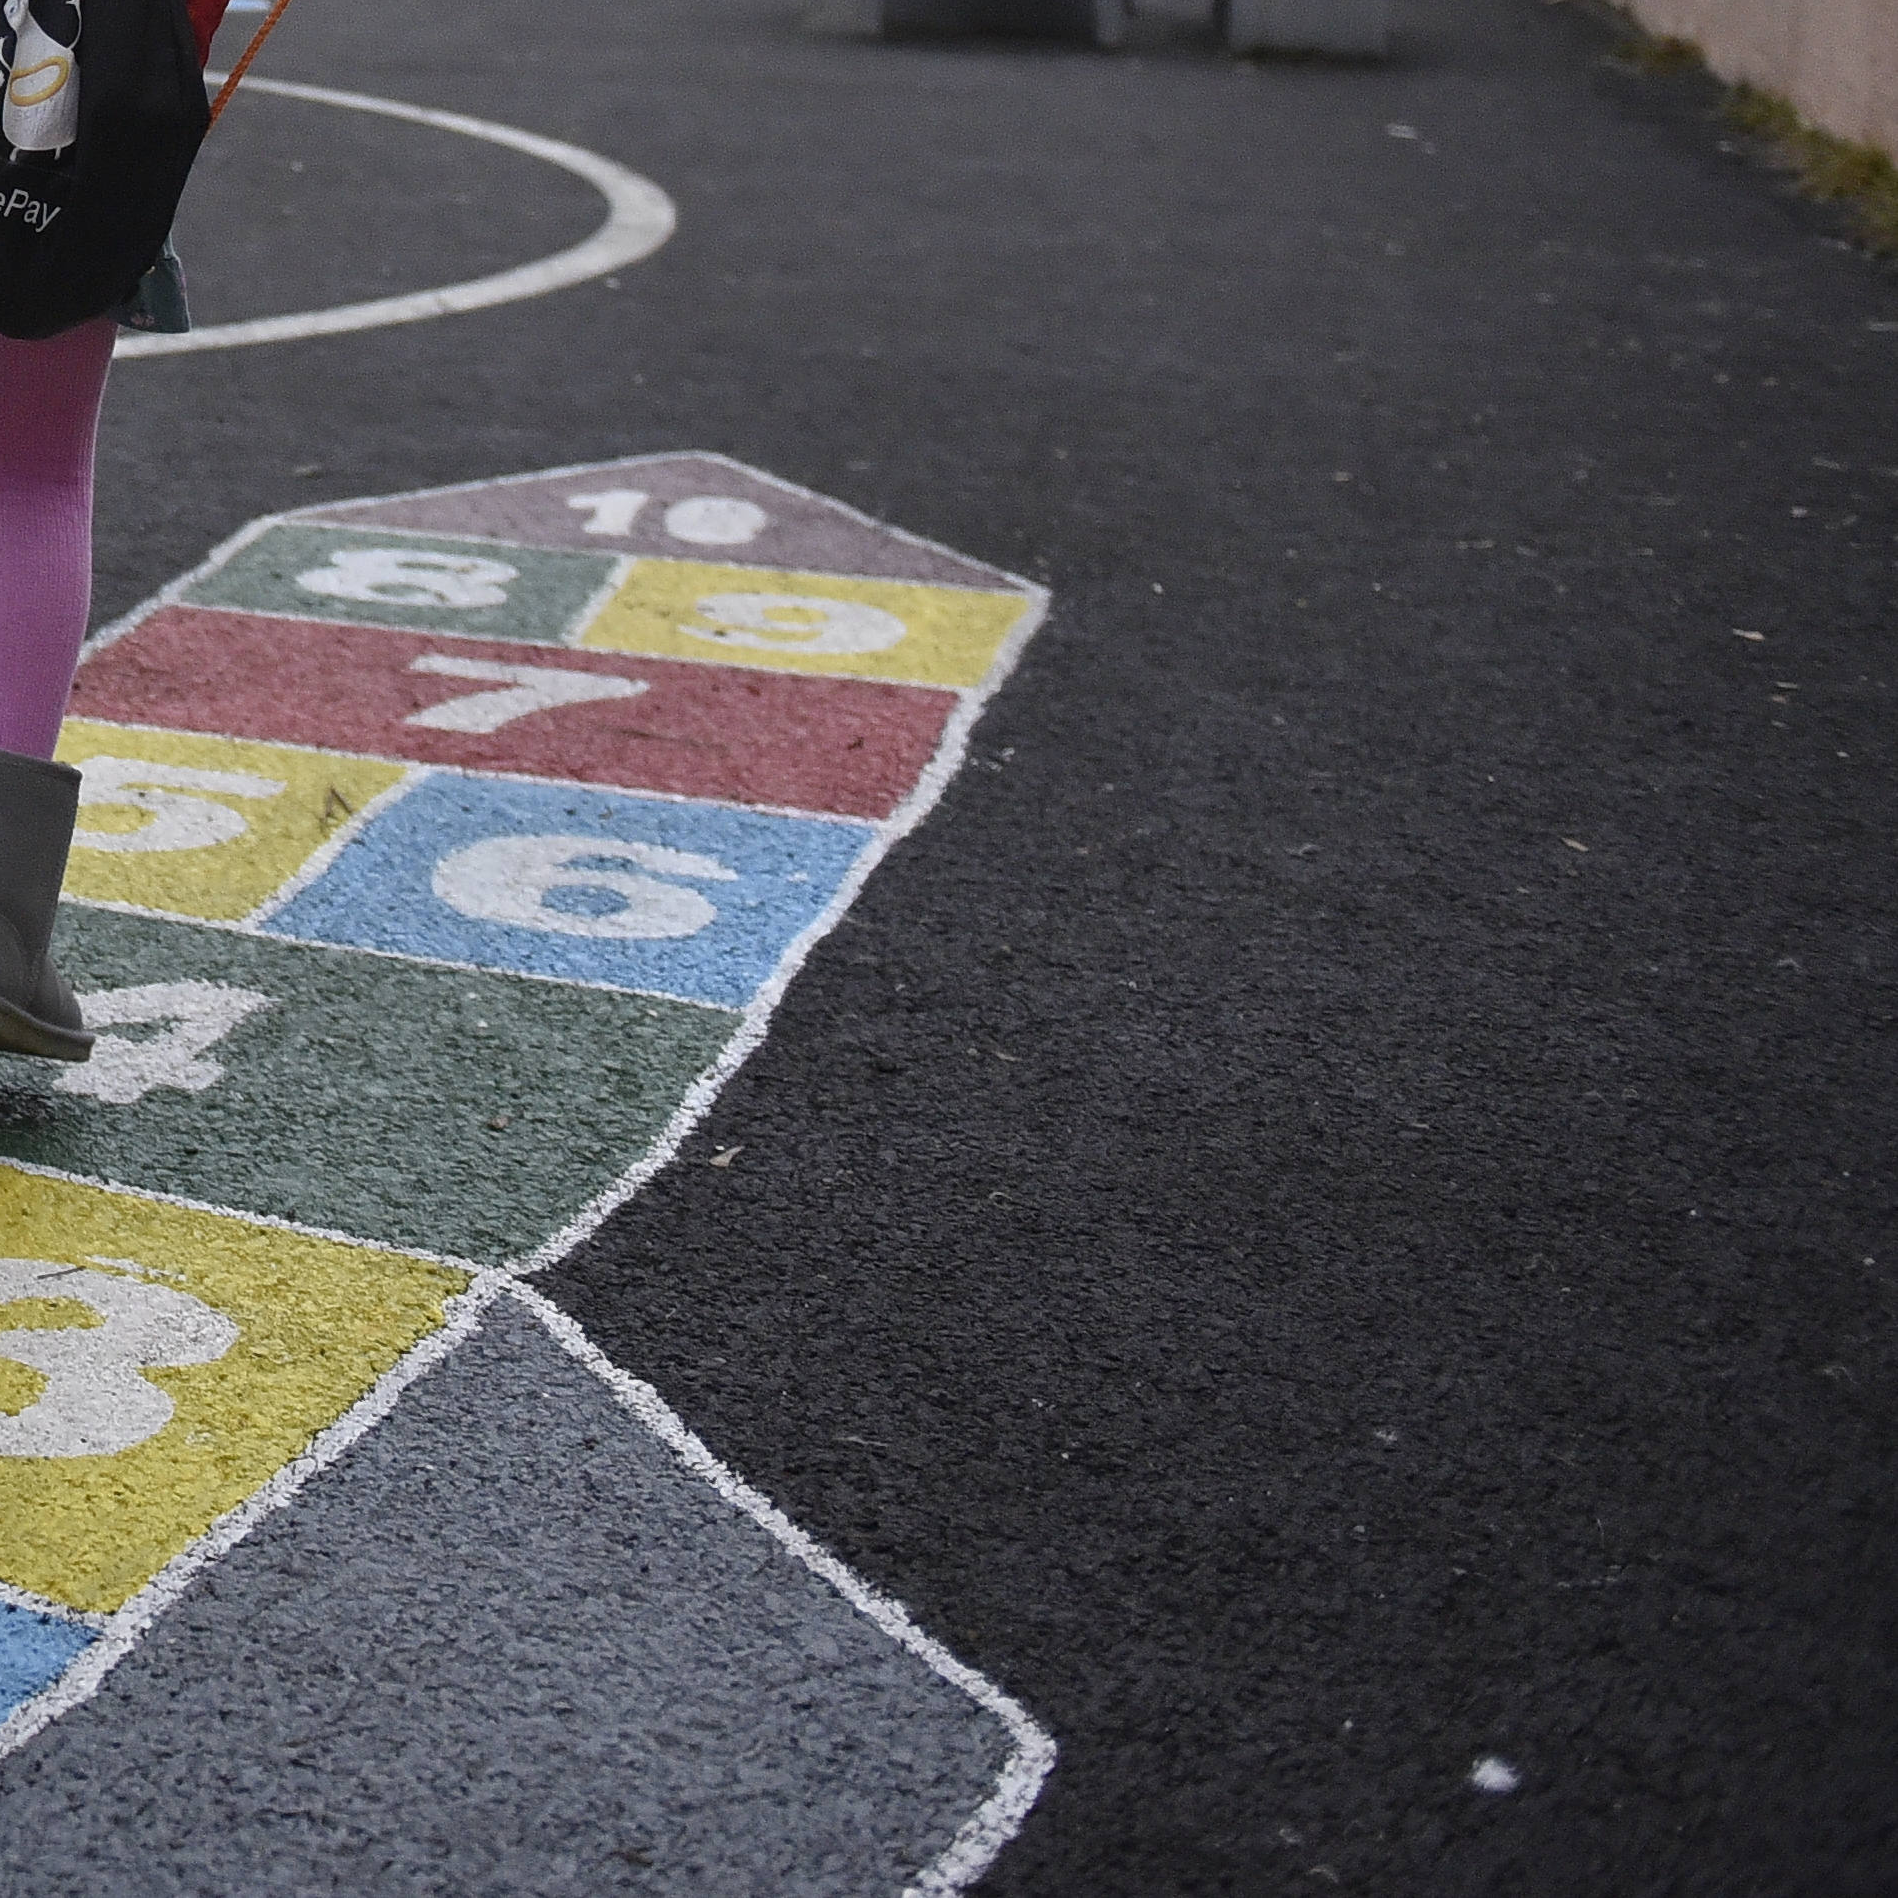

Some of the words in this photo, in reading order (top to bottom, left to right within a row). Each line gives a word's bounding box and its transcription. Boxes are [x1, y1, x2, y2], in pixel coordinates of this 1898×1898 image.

[567, 489, 767, 545] 10
[296, 548, 520, 608] 8
[678, 592, 907, 655] 9
[405, 652, 650, 735] 7
[72, 755, 288, 853] 5
[431, 834, 740, 940] 6
